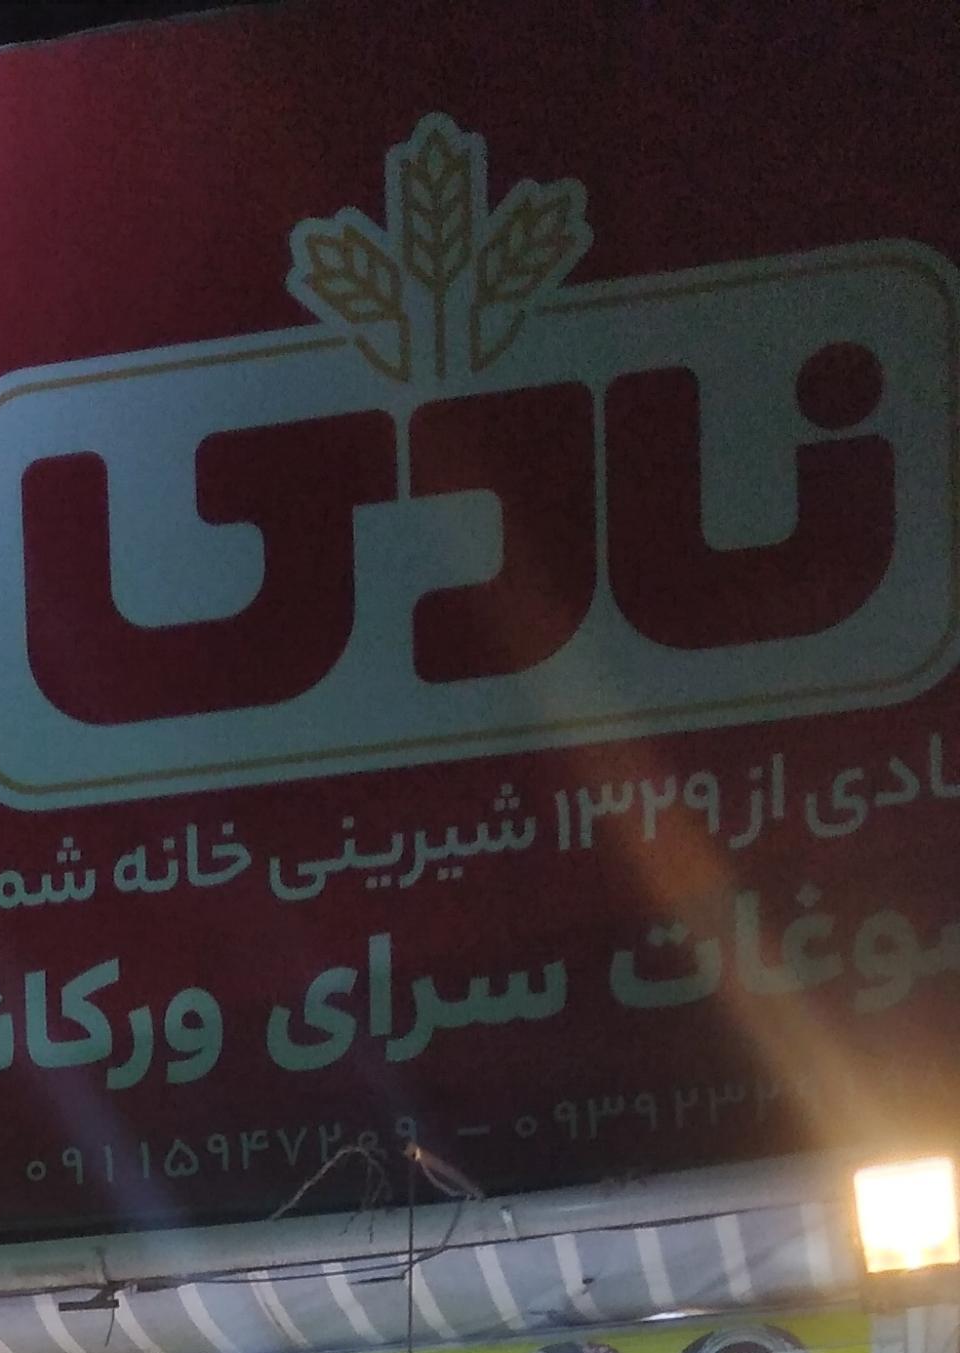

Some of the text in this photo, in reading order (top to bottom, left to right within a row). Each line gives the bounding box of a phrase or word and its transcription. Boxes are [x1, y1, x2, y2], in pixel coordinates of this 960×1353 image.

[21, 341, 895, 725] نادی
[555, 769, 720, 851] ۱۳۲۹
[729, 752, 785, 850] از
[803, 732, 960, 838] ادی
[113, 821, 253, 893] خانه
[268, 783, 536, 901] شیرینی
[266, 932, 568, 1062] سرای
